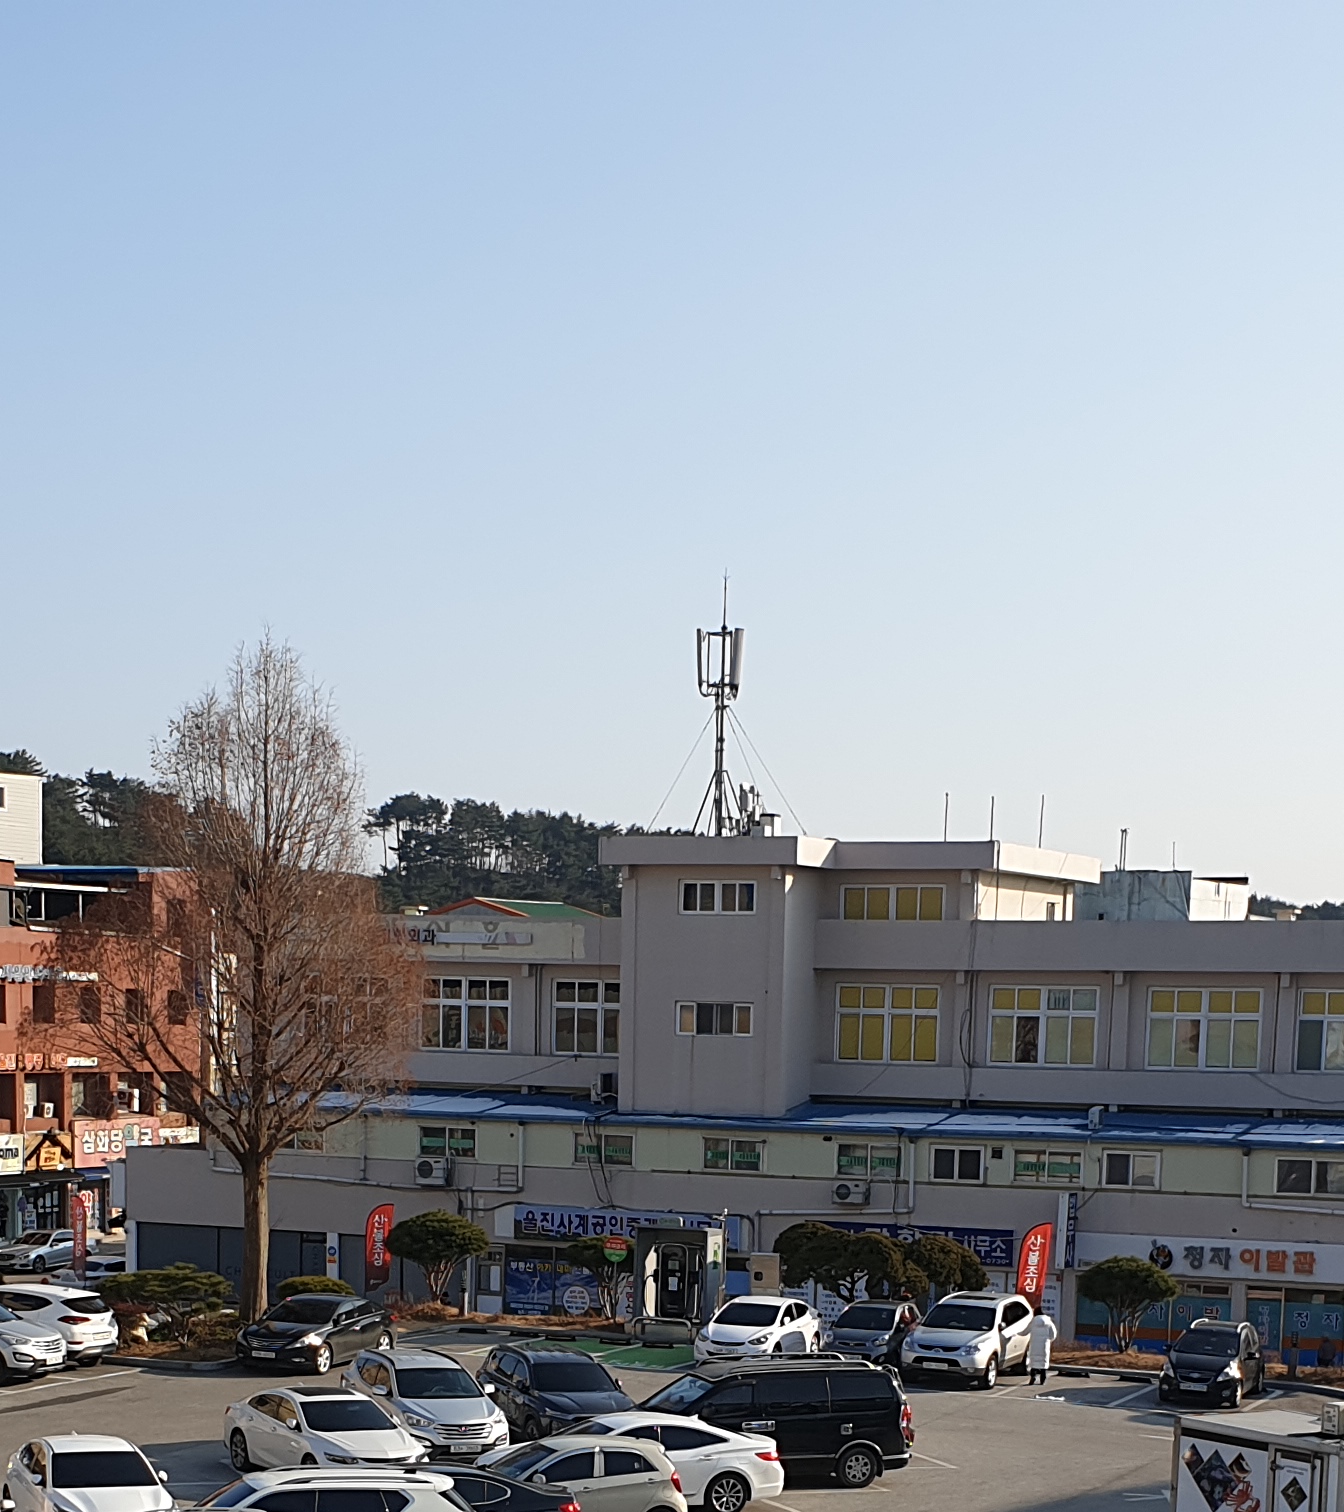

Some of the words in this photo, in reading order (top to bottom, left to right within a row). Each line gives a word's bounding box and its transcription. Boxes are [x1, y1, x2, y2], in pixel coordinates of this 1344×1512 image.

[372, 1214, 388, 1267] 산불조심
[510, 1261, 534, 1272] 부동산
[1022, 1234, 1046, 1293] 산불조심
